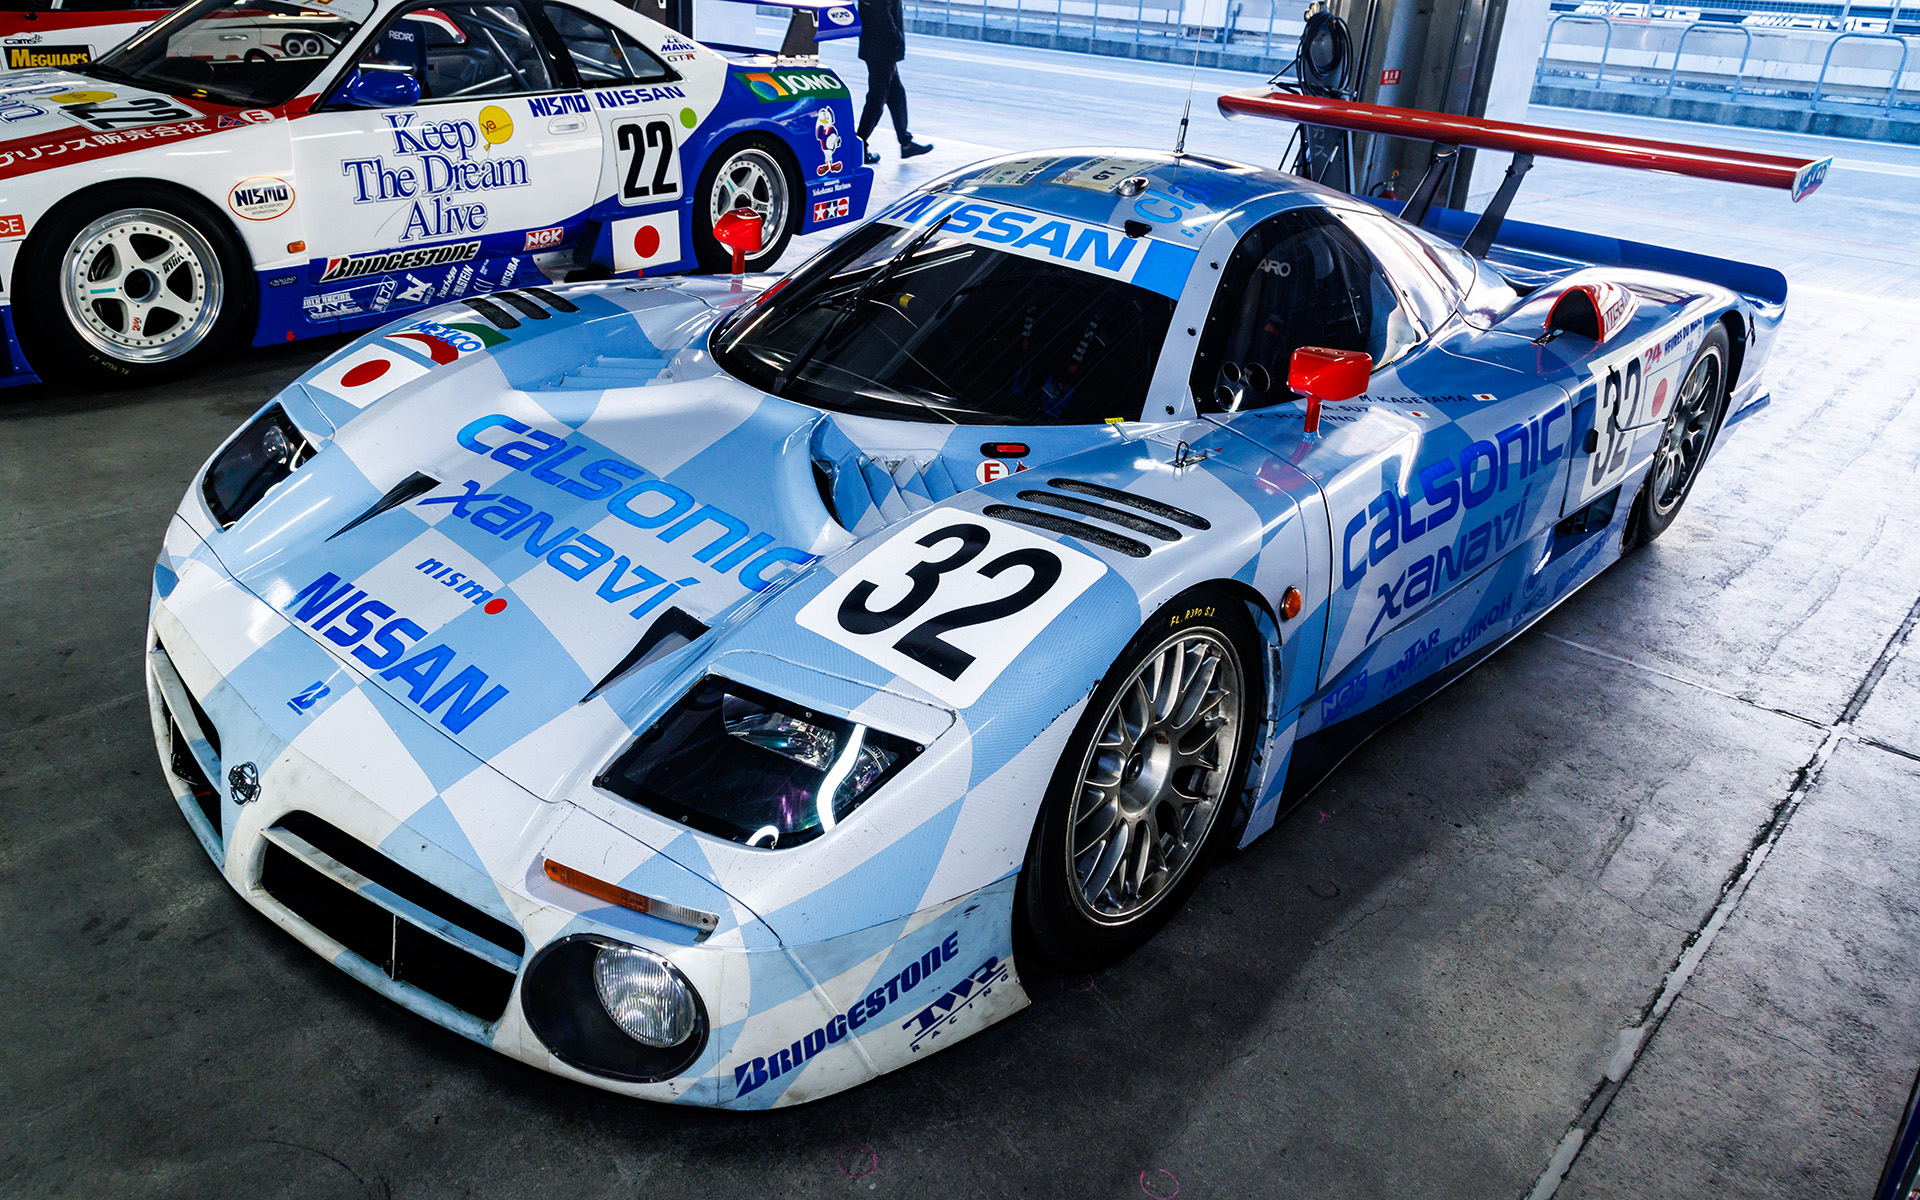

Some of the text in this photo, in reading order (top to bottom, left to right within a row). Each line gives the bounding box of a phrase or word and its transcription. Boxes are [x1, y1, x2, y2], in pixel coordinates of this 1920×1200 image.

[11, 49, 88, 67] MEGUIAR'S
[388, 30, 415, 42] RECARO
[527, 86, 686, 118] NISMO NISSAN
[778, 74, 842, 95] JOMO
[254, 110, 271, 122] E
[383, 112, 477, 161] Keep
[342, 154, 530, 203] The Dream
[617, 121, 678, 199] 22
[234, 184, 289, 207] NISMO
[400, 195, 487, 241] Alive
[527, 229, 563, 246] NGK
[889, 194, 1138, 273] NISSAN
[321, 242, 481, 282] BRIDGESTONE
[409, 319, 482, 352] MEXICO
[1644, 342, 1662, 374] 24
[1377, 394, 1470, 404] KAGEYAMA
[1592, 356, 1642, 487] 32
[984, 463, 1000, 483] E
[837, 523, 1063, 682] 32
[1444, 591, 1513, 666] ICHIKOH
[284, 571, 510, 735] NISSAN
[1382, 627, 1441, 691] ANTAR
[1322, 669, 1367, 719] NGK
[734, 930, 959, 1099] BRIDGESTONE
[901, 955, 1007, 1037] TWR
[911, 972, 1010, 1054] RACING
